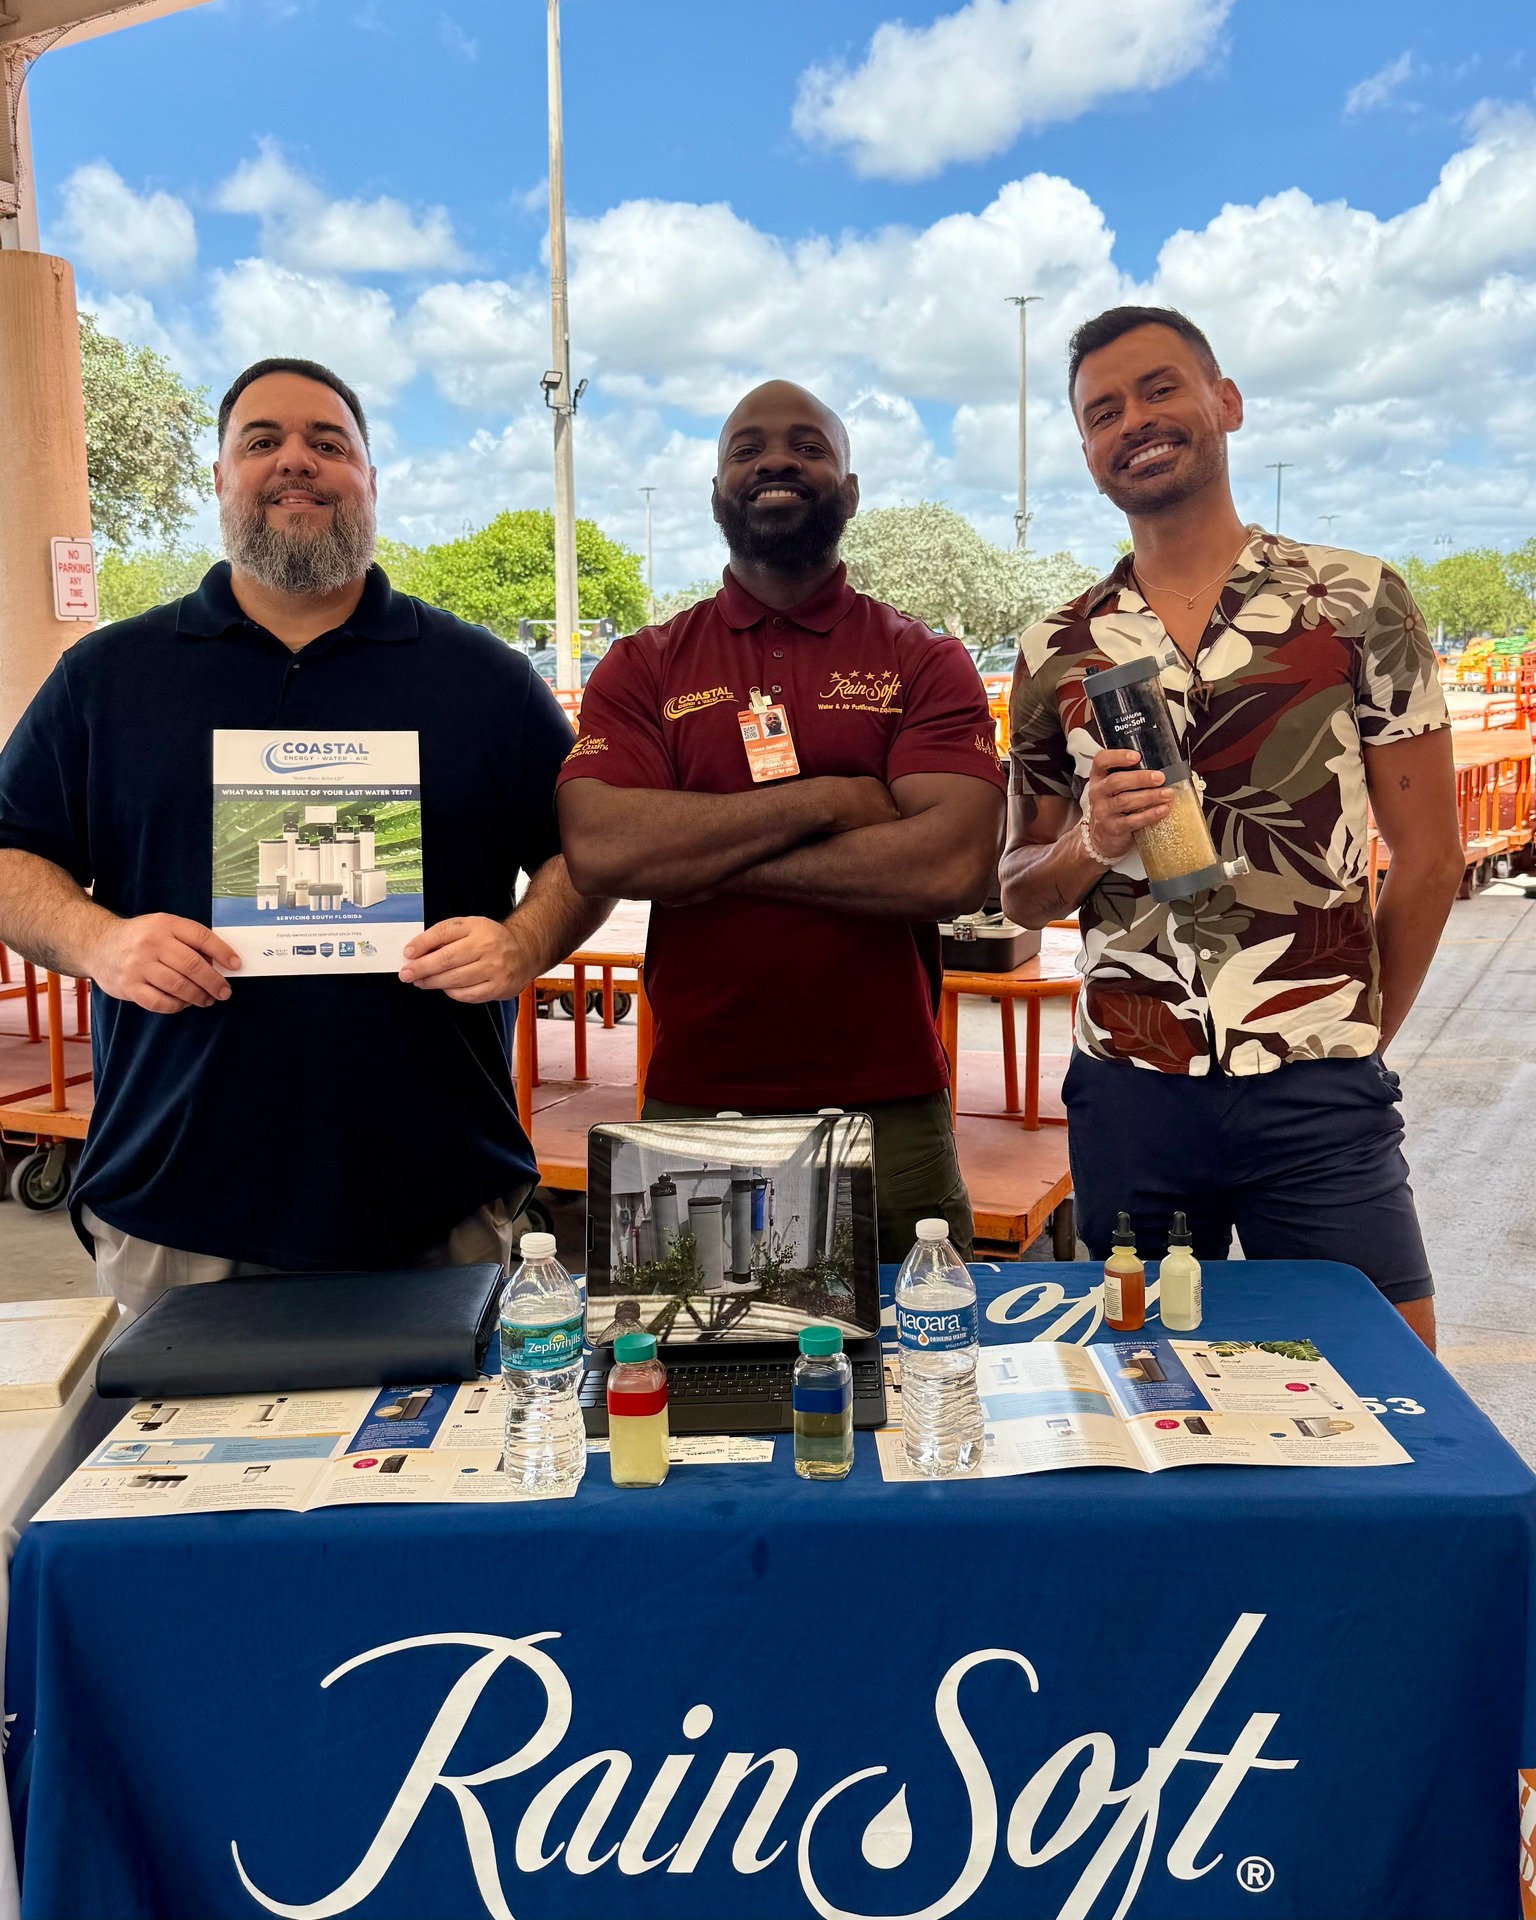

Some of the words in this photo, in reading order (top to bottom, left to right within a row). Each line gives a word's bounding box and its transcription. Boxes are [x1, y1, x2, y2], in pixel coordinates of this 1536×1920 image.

[68, 550, 80, 560] NO
[58, 562, 91, 574] PARKING
[70, 577, 82, 586] ANY
[69, 588, 84, 598] TIME
[678, 686, 734, 704] COASTAL
[282, 742, 370, 754] COASTAL
[898, 1309, 961, 1340] niagara
[528, 1333, 581, 1354] Zephyrhills
[929, 1335, 953, 1343] DRINKING
[952, 1332, 967, 1340] WATER
